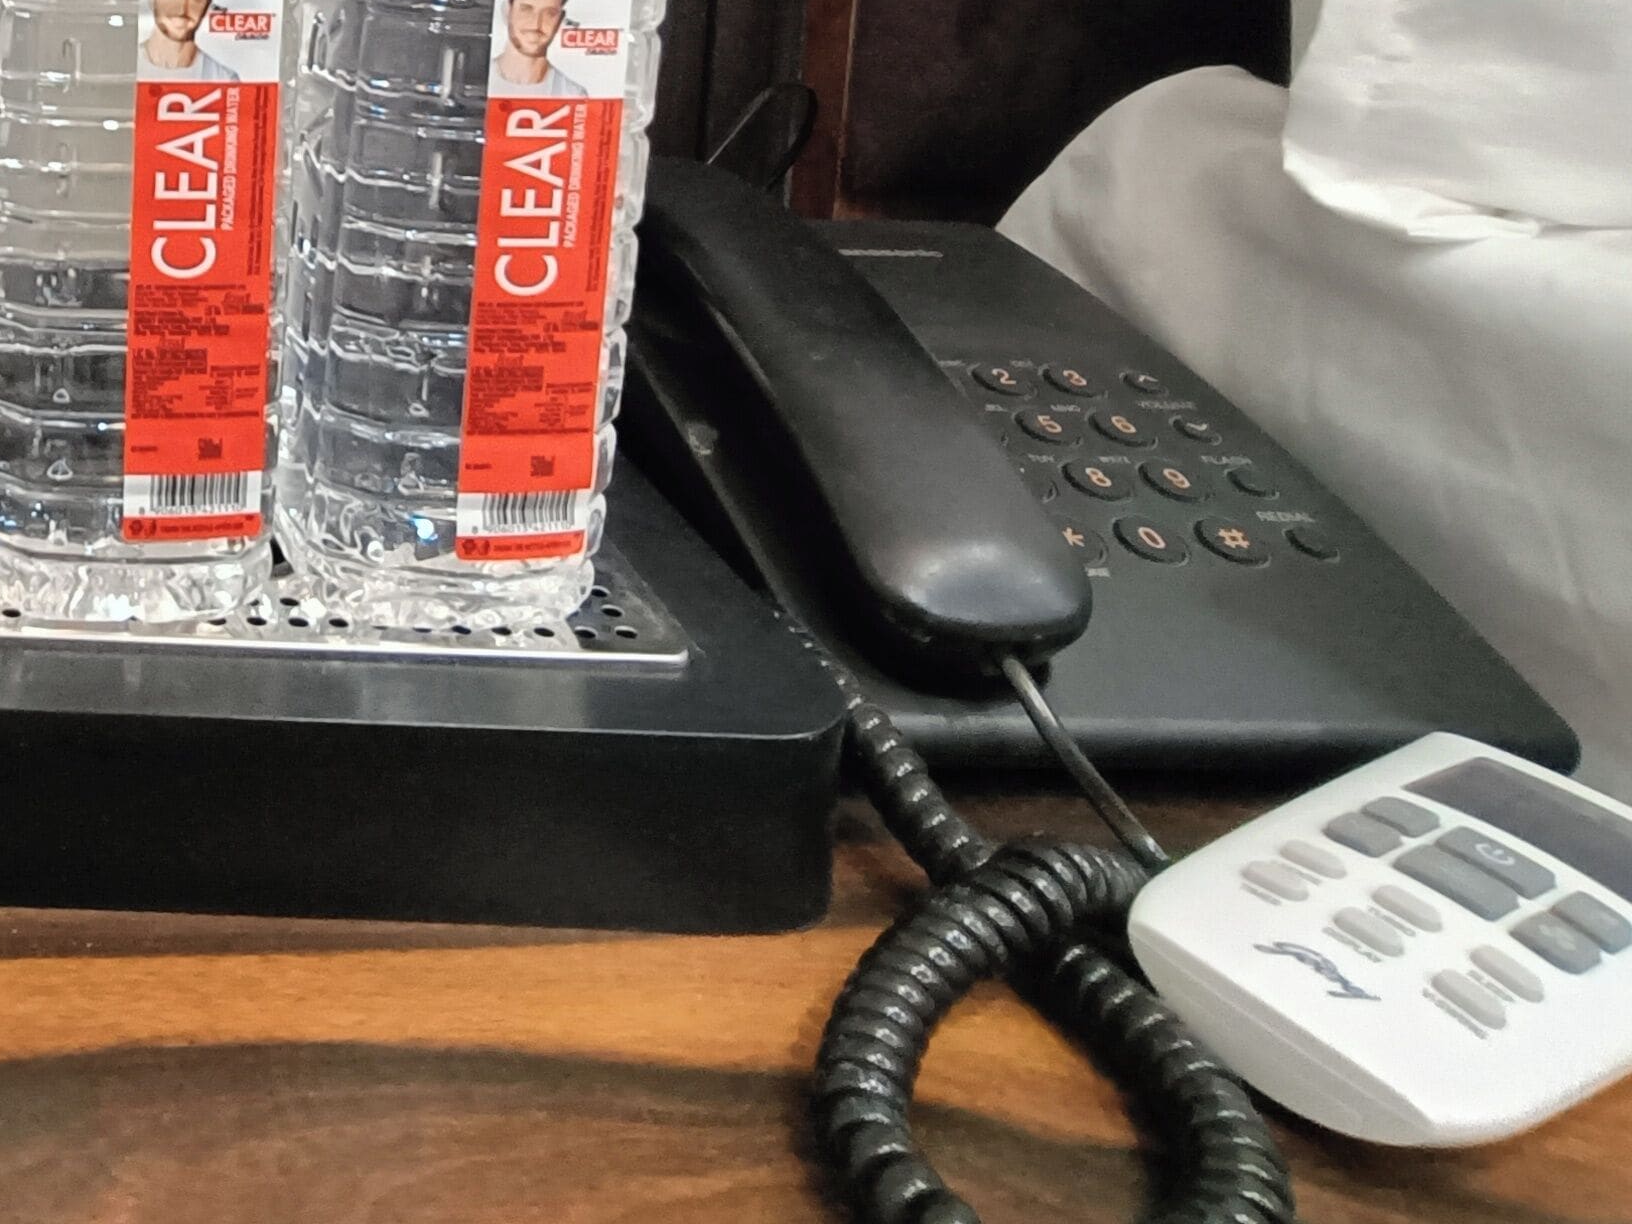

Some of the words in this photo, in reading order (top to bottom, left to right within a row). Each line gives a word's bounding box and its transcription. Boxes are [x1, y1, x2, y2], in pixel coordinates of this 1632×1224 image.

[211, 15, 269, 32] CLEAR
[563, 30, 616, 47] CLEAR
[225, 87, 240, 124] WATER
[572, 103, 588, 140] WATER
[224, 125, 239, 175] DRINKING
[567, 141, 585, 191] DRINKING
[150, 87, 223, 279] CLEAR
[220, 176, 237, 232] PACKAGED
[494, 104, 572, 297] CLEAR
[562, 191, 581, 249] PACKAGED
[991, 368, 1017, 385] 2
[1063, 370, 1088, 387] 3
[1037, 415, 1063, 434] 5
[1110, 415, 1137, 434] 6
[1085, 467, 1112, 487] 8
[1162, 468, 1191, 489] 9
[1137, 526, 1166, 550] 0
